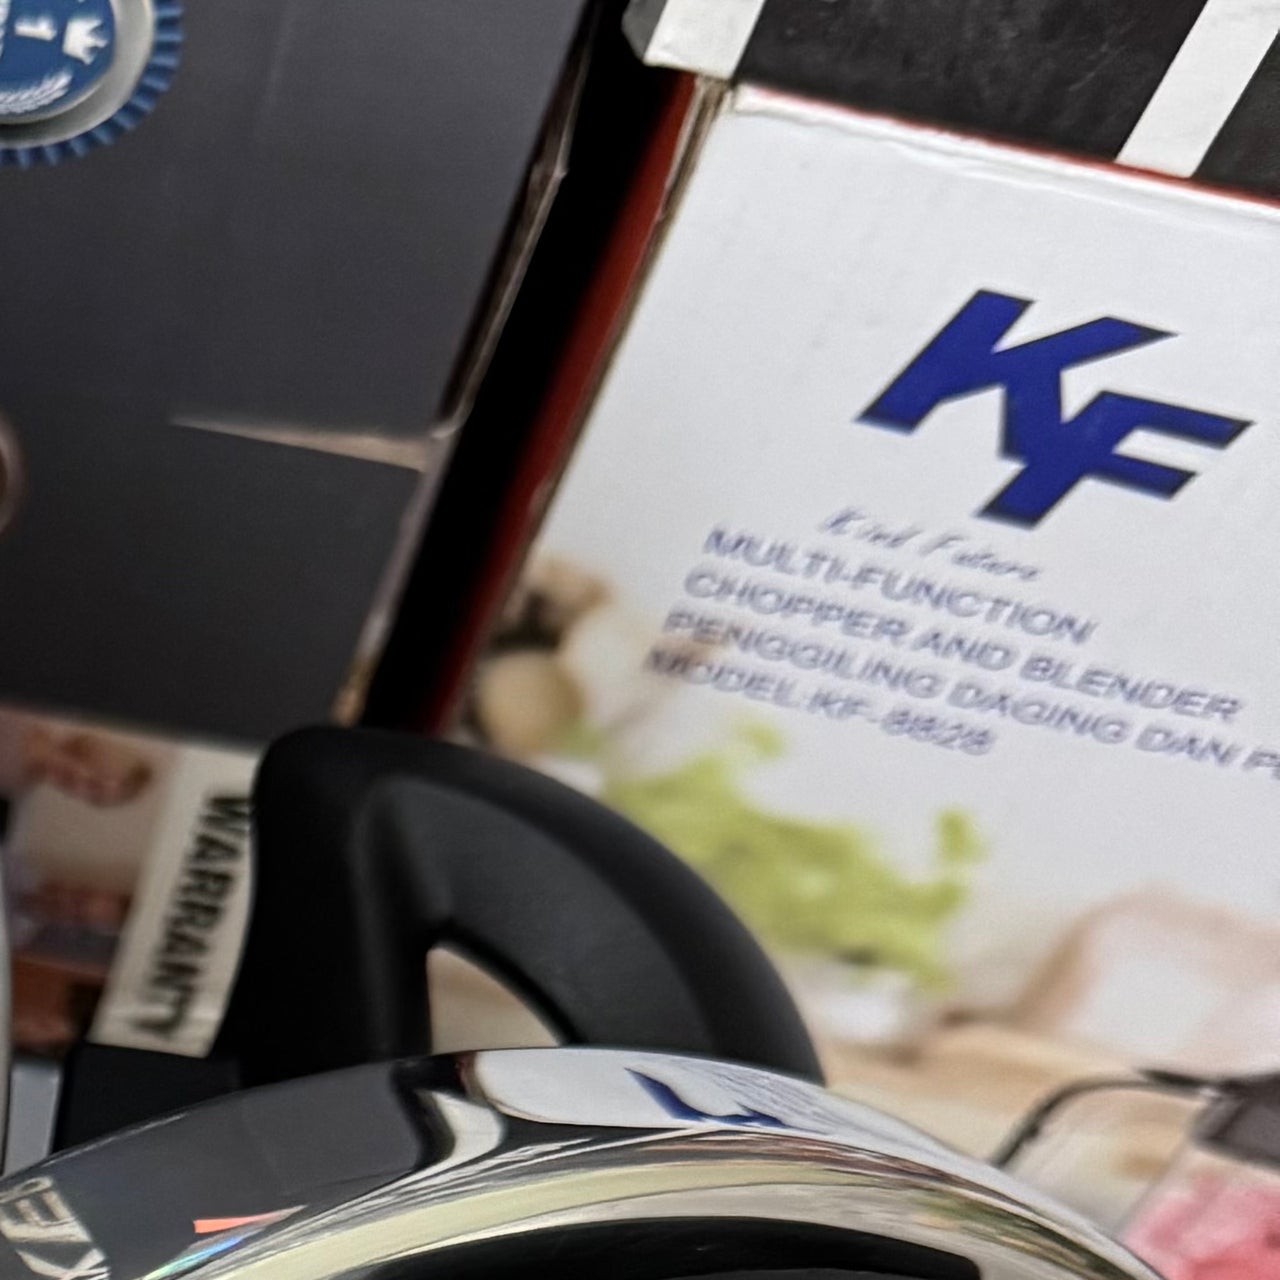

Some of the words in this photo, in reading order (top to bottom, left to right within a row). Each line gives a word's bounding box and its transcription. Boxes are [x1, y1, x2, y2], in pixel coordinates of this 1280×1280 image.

[853, 289, 1258, 531] KF
[683, 570, 910, 645] CHOPPER
[910, 628, 1014, 672] AND
[1018, 655, 1244, 724] BLENDER
[946, 680, 1132, 747] DAGING
[1135, 726, 1237, 769] DAN
[128, 796, 254, 1038] WARRANTY
